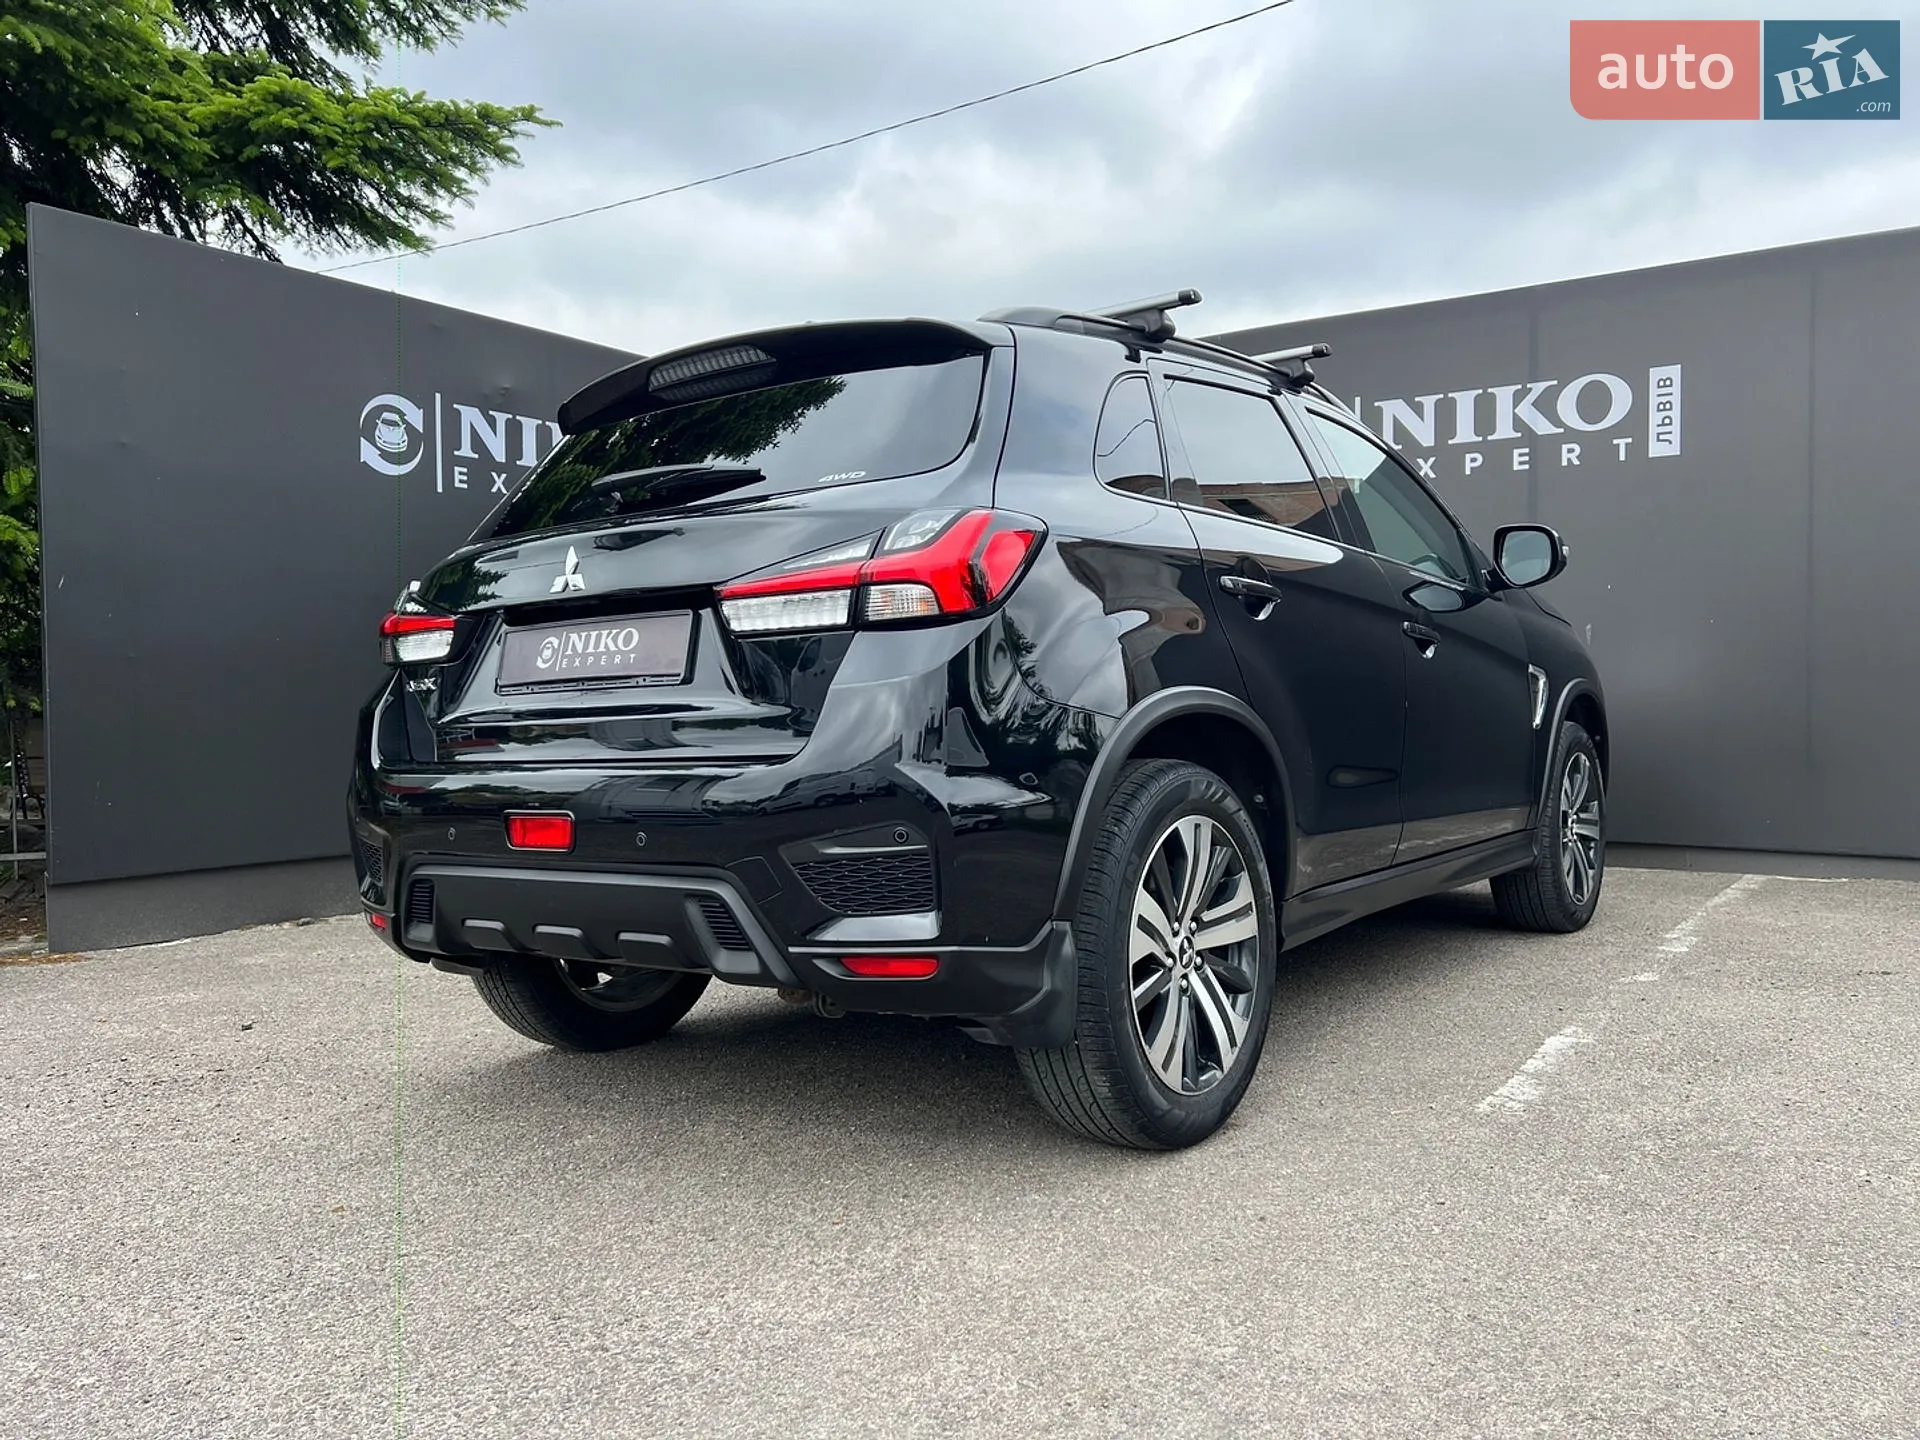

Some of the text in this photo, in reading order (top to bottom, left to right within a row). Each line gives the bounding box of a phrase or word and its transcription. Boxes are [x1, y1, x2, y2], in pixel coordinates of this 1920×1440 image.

[1374, 373, 1633, 450] NIKO
[1655, 375, 1674, 445] ЛЬВІВ
[562, 653, 637, 668] EXPERT
[565, 628, 640, 655] NIKO
